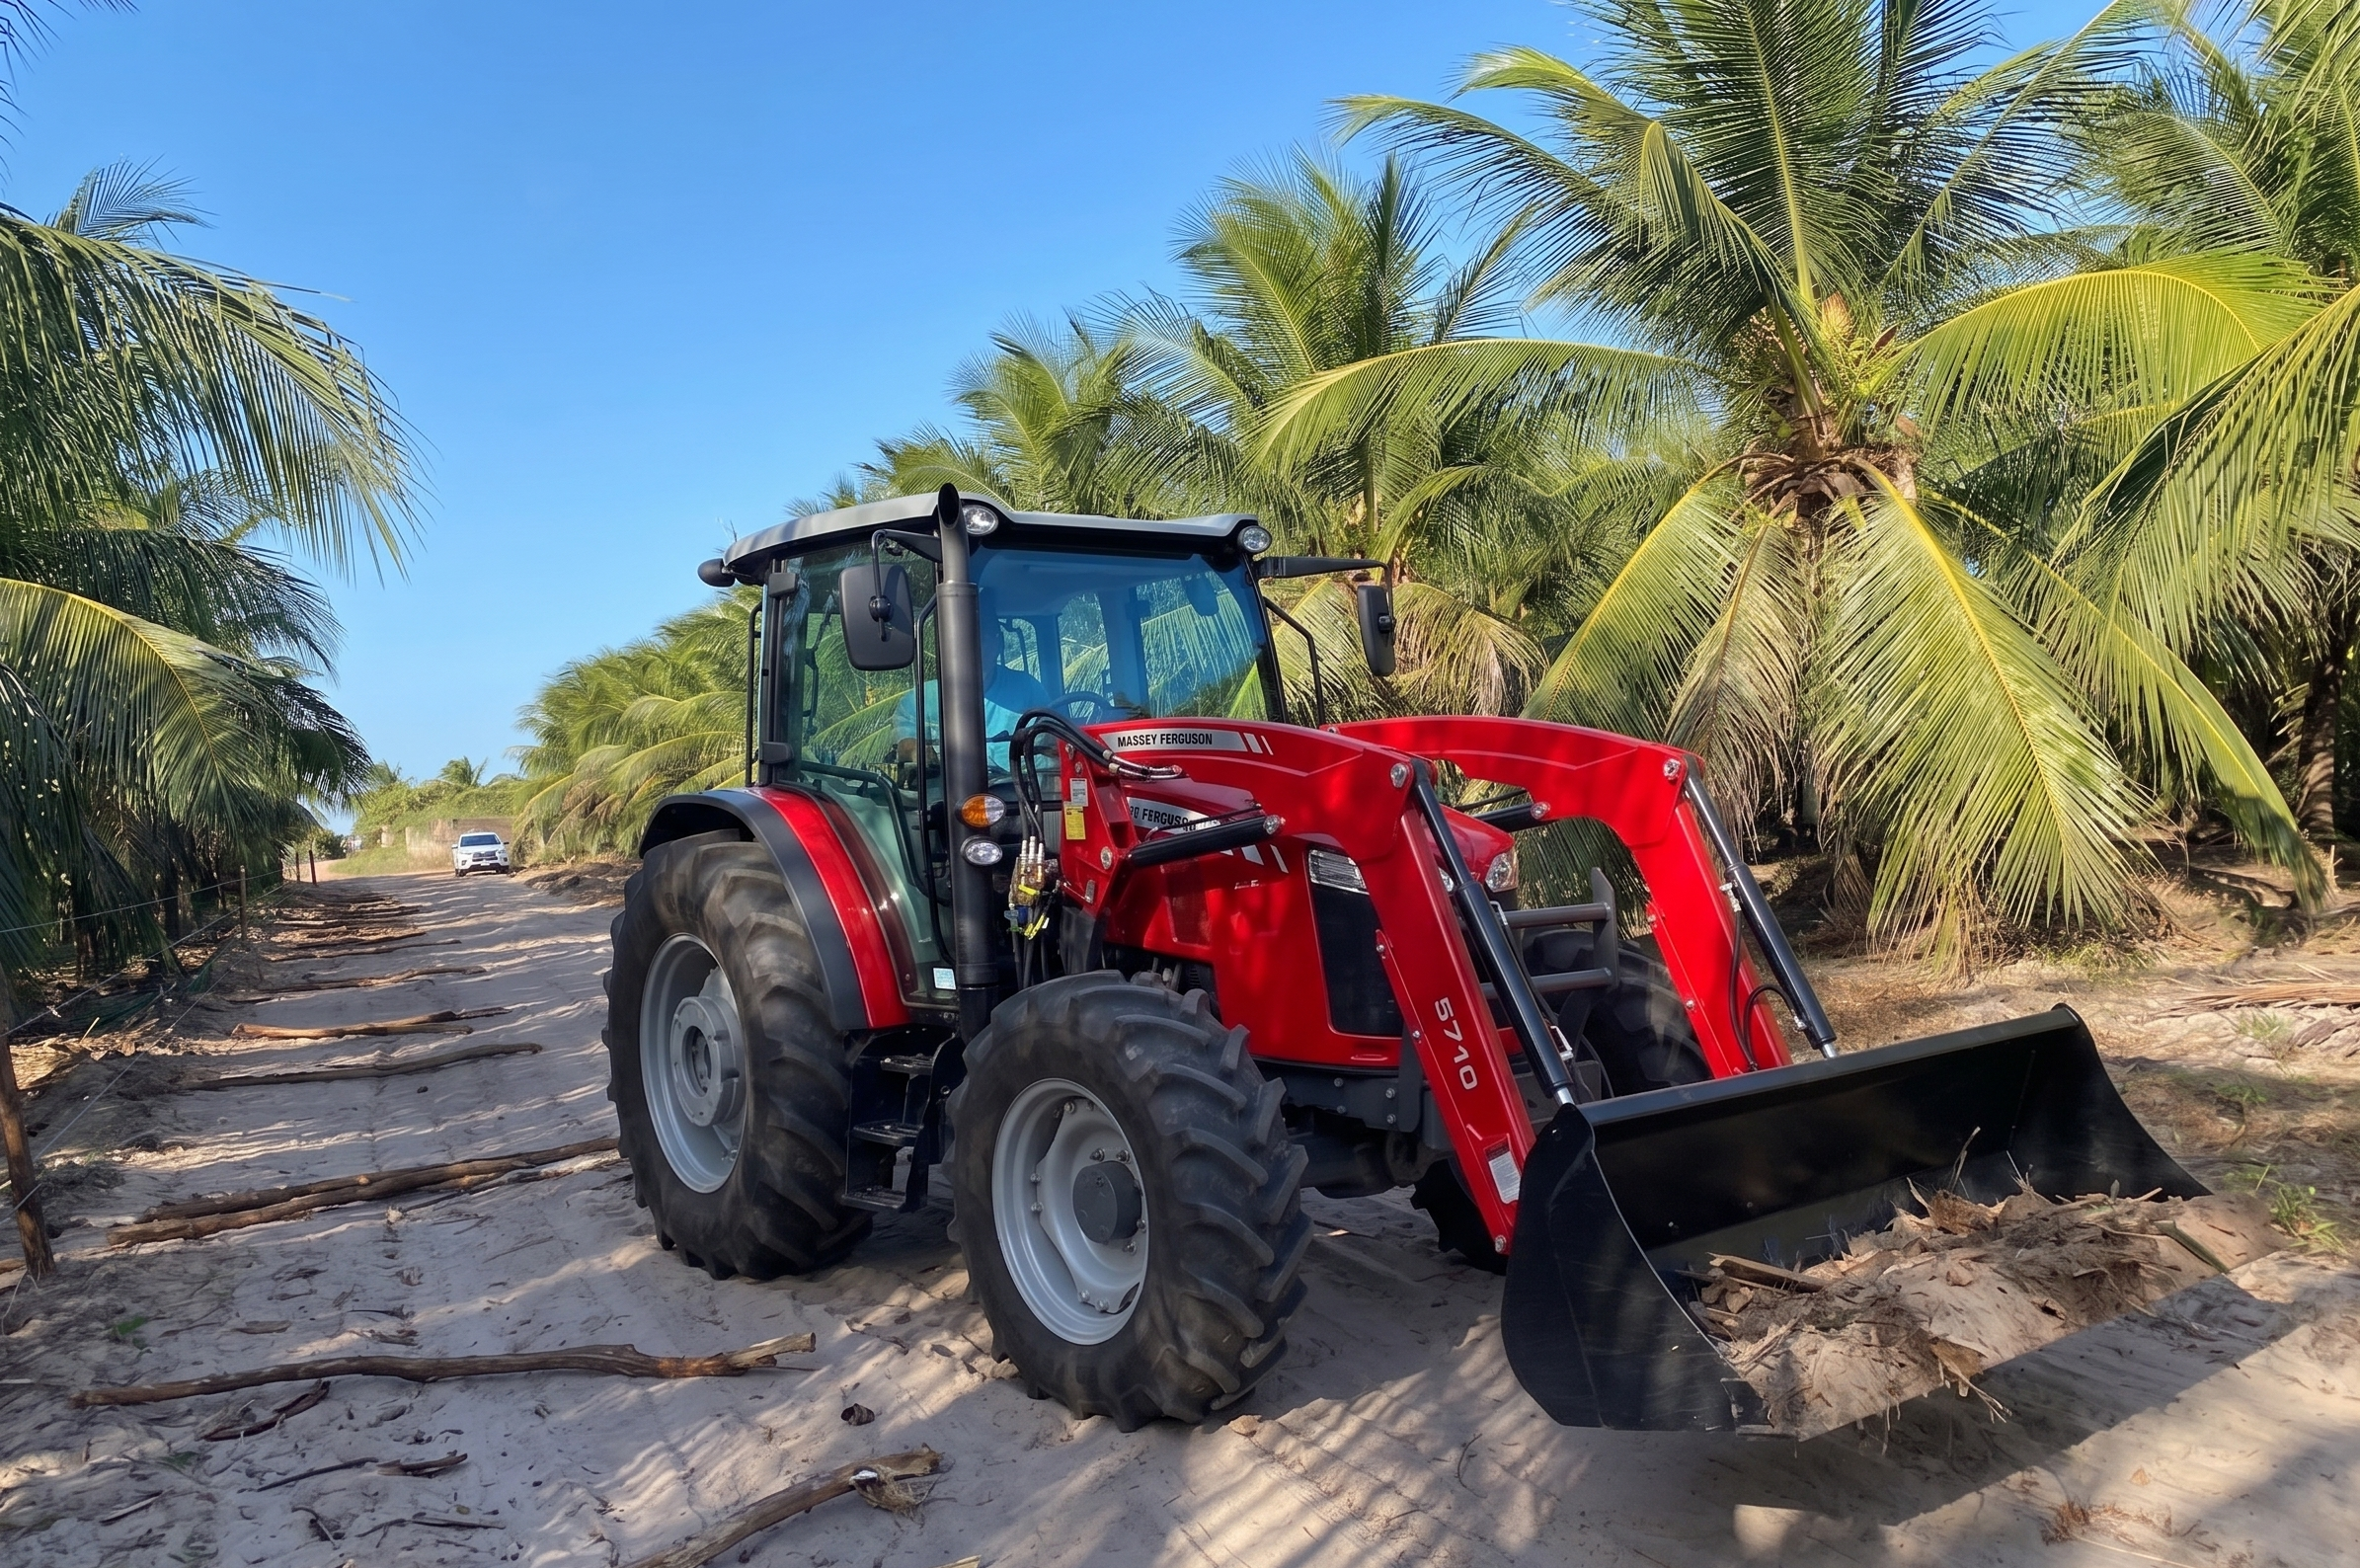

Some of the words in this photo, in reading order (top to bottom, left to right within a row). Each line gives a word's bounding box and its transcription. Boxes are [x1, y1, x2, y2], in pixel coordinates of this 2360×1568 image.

[1118, 734, 1157, 747] MASSEY
[1160, 733, 1213, 745] FERGUSON
[1435, 996, 1478, 1090] 5710
